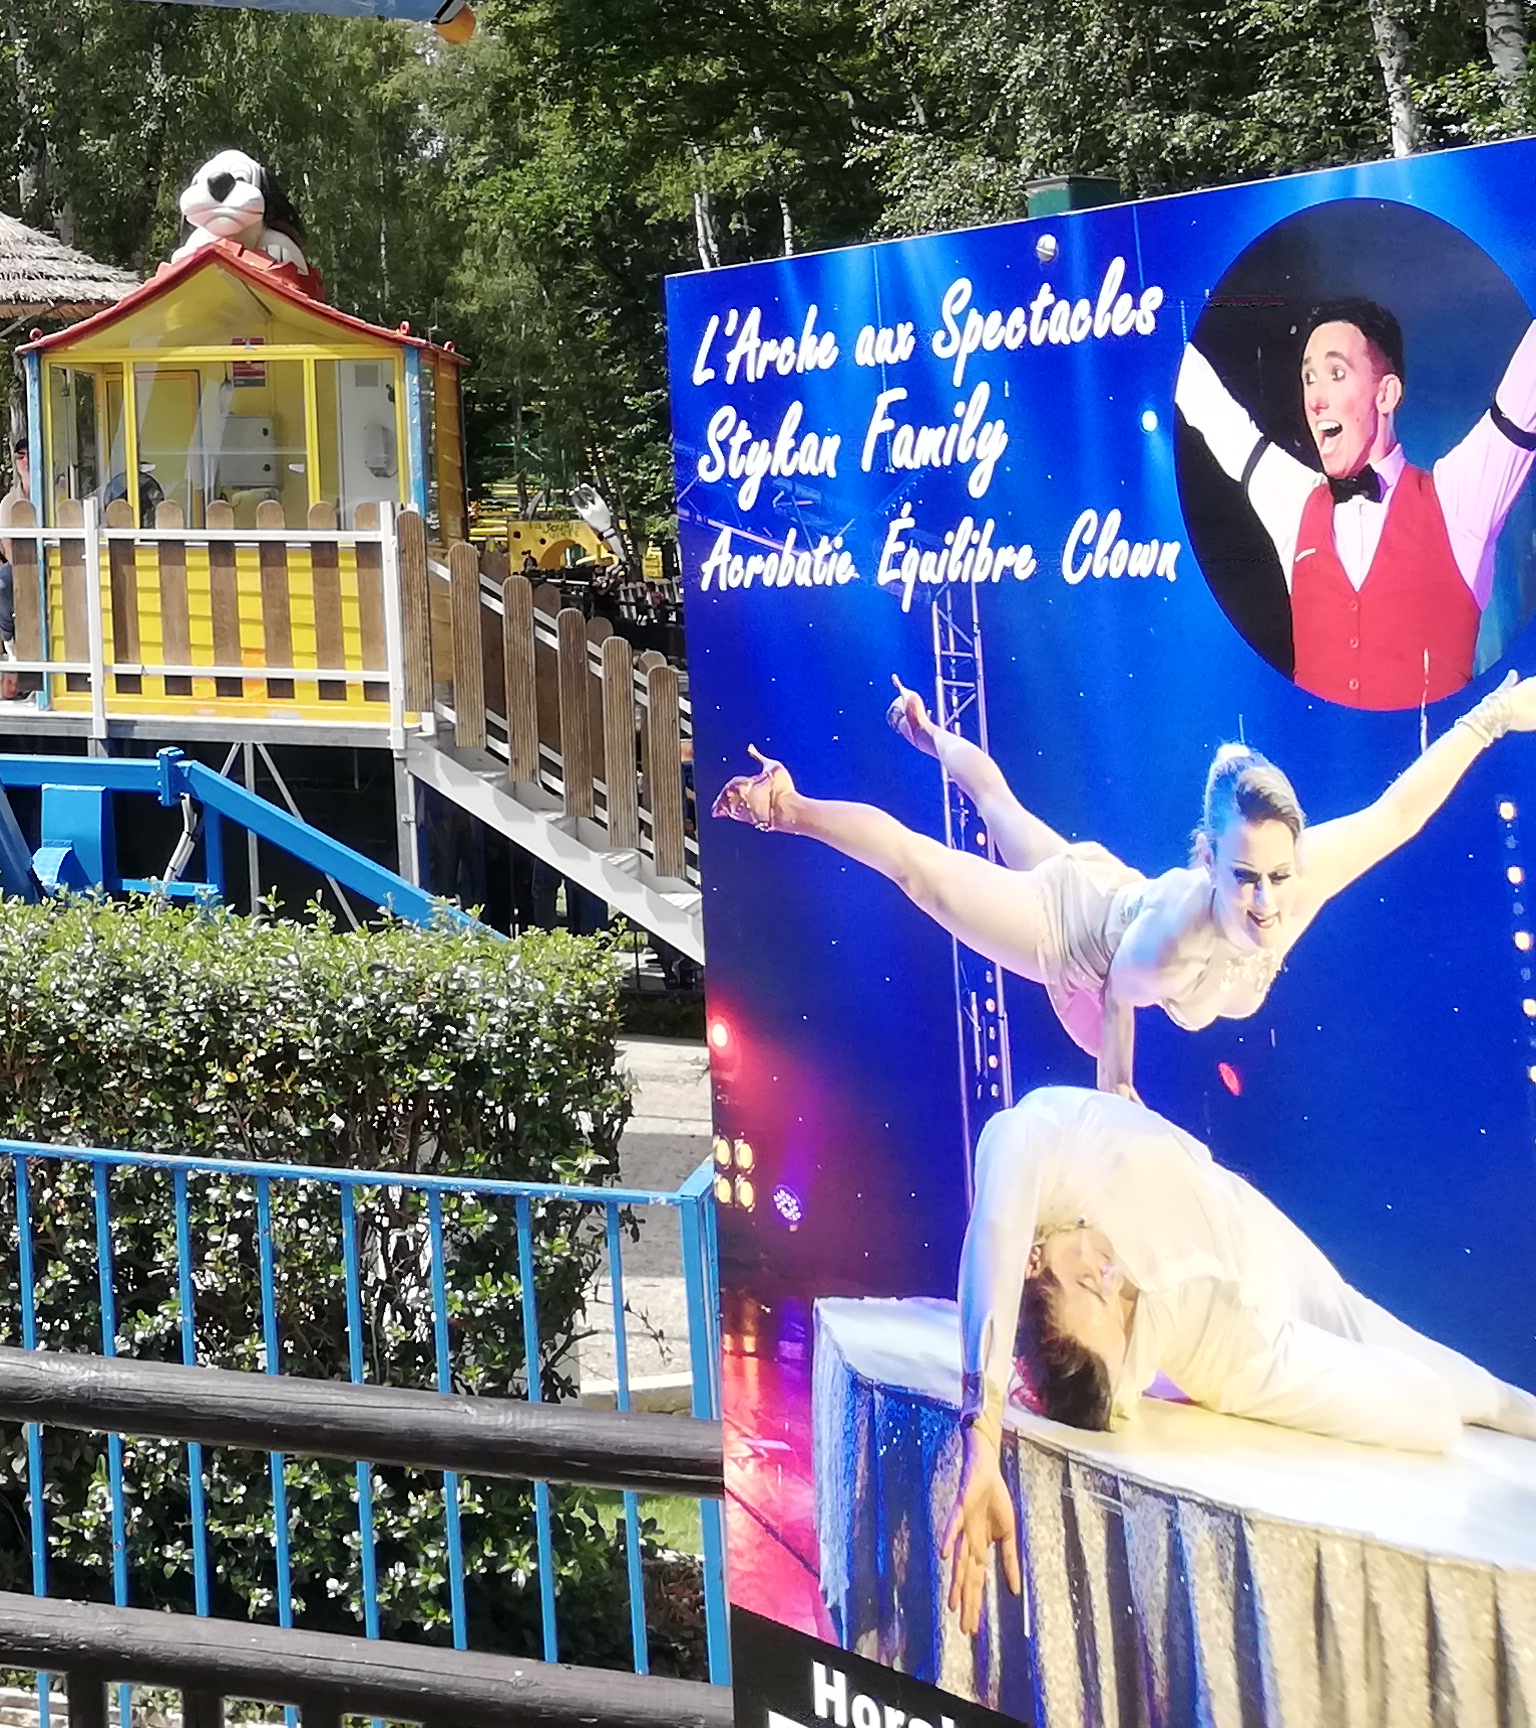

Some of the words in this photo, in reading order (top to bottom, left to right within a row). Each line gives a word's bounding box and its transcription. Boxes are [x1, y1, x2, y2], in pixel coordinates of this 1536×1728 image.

[691, 303, 839, 387] L'Arche
[854, 320, 917, 368] aux
[931, 255, 1165, 388] Spectacles
[860, 380, 1009, 500] Family
[699, 524, 854, 593] Acrobatie
[876, 501, 1038, 614] Équilibre
[1061, 507, 1182, 586] Clown
